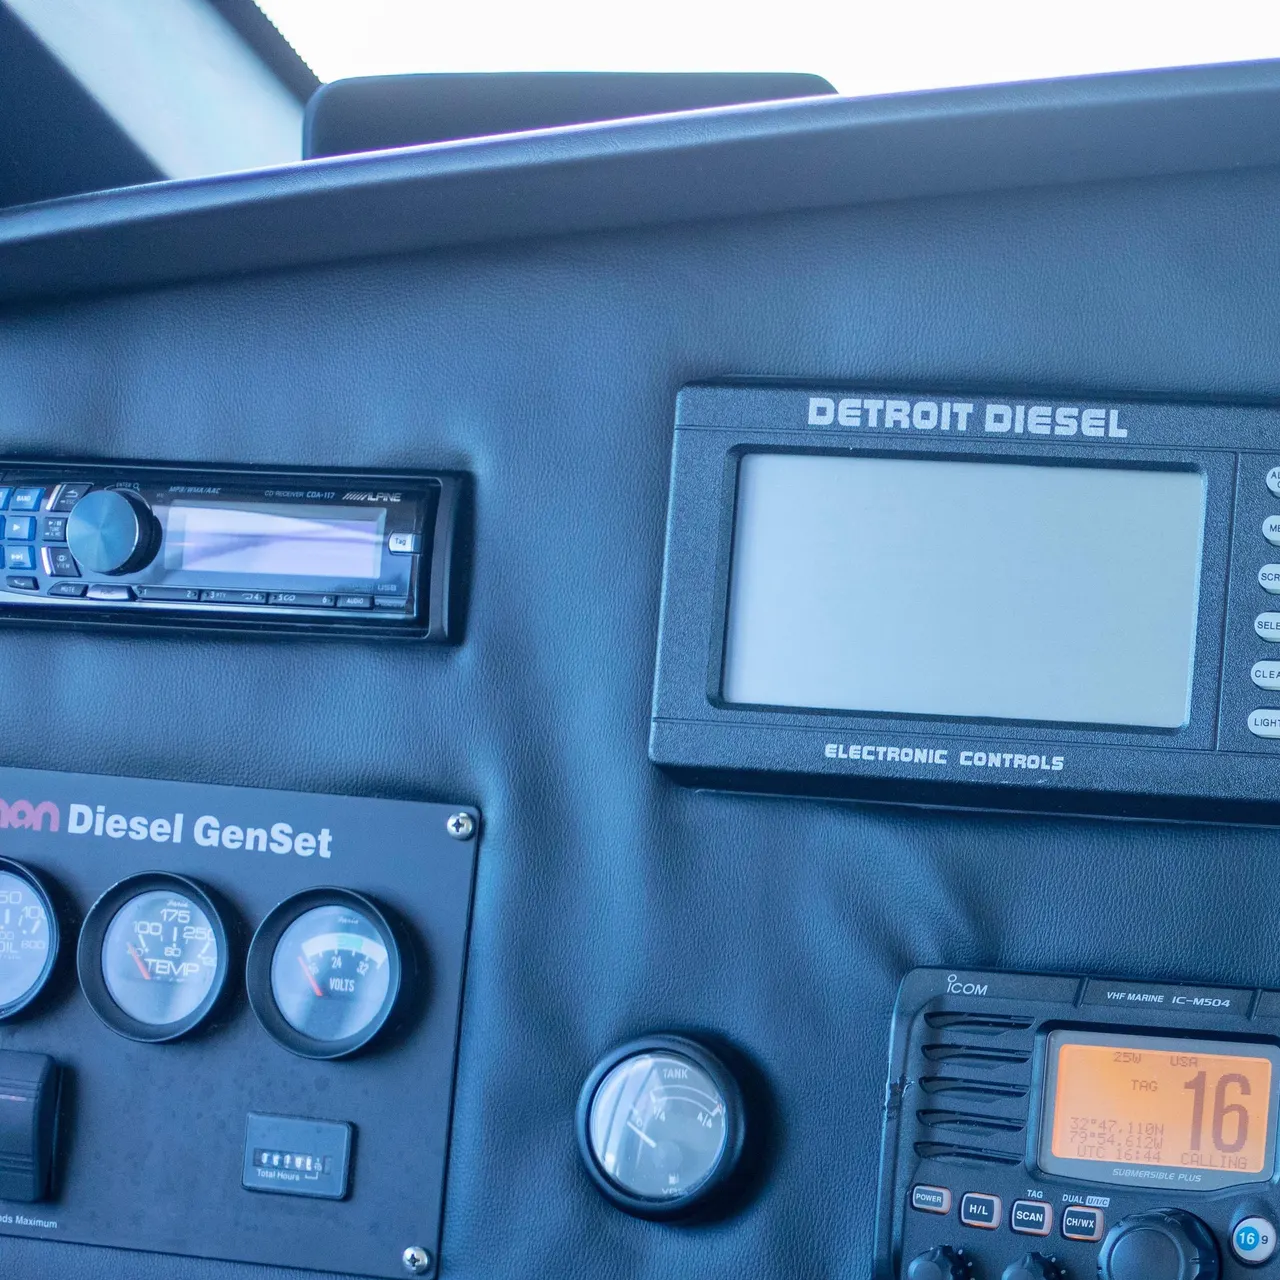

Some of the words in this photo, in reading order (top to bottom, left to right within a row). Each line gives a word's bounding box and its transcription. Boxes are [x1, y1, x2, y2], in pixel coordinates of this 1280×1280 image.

[807, 397, 974, 432] DETROIT
[984, 403, 1128, 438] DIESEL
[275, 490, 304, 499] RECEIVER
[360, 491, 402, 502] ALPINE
[824, 743, 948, 765] ELECTRONIC
[959, 750, 1065, 771] CONTROLS
[67, 803, 184, 844] Diesel
[193, 814, 333, 859] GenSet
[160, 907, 191, 924] 175
[133, 920, 163, 936] 100
[144, 957, 201, 977] TEMP
[331, 956, 343, 969] 24
[356, 961, 370, 976] 32
[329, 976, 355, 992] VOLTS
[1106, 991, 1126, 1000] VHF
[1126, 992, 1164, 1003] MARINE
[1171, 995, 1231, 1008] IC-M504
[1113, 1051, 1142, 1064] 25W
[1169, 1055, 1199, 1068] USA
[662, 1068, 688, 1080] TANK
[1130, 1079, 1159, 1093] TAG
[1183, 1070, 1252, 1154] 16
[696, 1111, 713, 1129] 4/4
[1076, 1145, 1106, 1159] UTC
[1115, 1148, 1162, 1164] 16:44
[1180, 1153, 1248, 1170] CALLING
[256, 1168, 276, 1178] Total
[277, 1171, 300, 1182] Hours
[1111, 1168, 1176, 1181] SUBMERSIBLE
[1177, 1173, 1202, 1183] PLUS
[915, 1192, 943, 1204] POWER
[1026, 1189, 1044, 1199] TAG
[1062, 1193, 1085, 1205] DUAL
[969, 1203, 989, 1216] H/L
[1016, 1210, 1044, 1223] SCAN
[15, 1215, 58, 1229] Maximum
[1066, 1216, 1095, 1229] CH/WX
[1239, 1231, 1255, 1245] 16
[1261, 1235, 1269, 1245] 9
